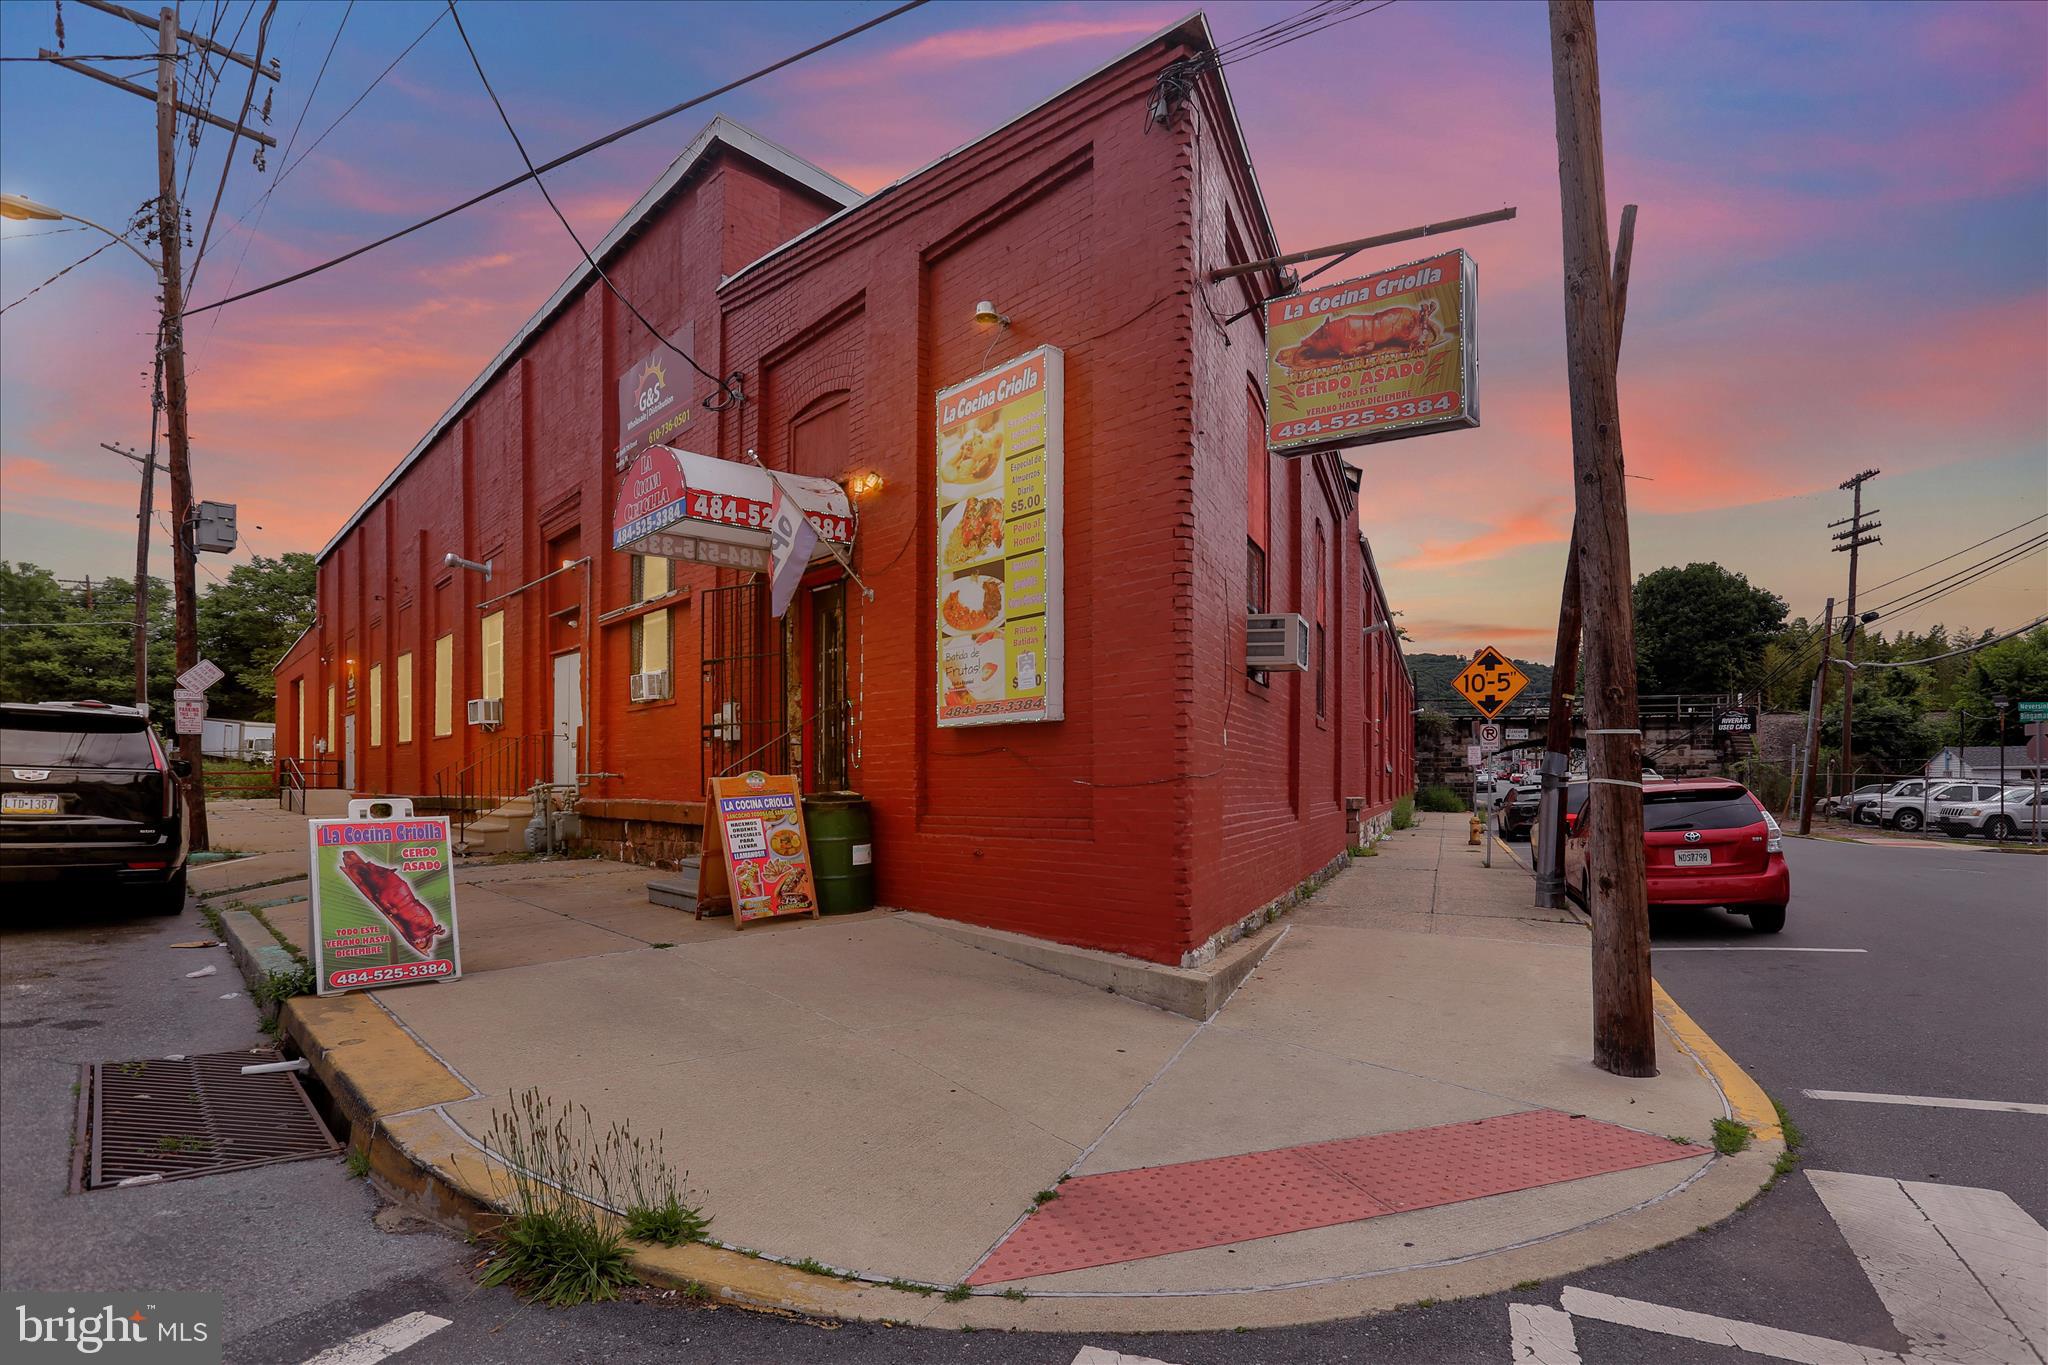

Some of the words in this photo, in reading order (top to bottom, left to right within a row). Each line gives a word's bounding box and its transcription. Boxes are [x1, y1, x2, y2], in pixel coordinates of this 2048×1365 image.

[1283, 304, 1303, 320] La
[1309, 288, 1370, 314] Cocina
[1376, 267, 1442, 297] Criolla
[1295, 375, 1351, 398] CERDO
[1360, 360, 1425, 385] ASADO
[639, 382, 660, 412] G&S
[943, 405, 955, 425] La
[958, 389, 995, 418] Cocina
[997, 367, 1038, 401] Criolla
[1338, 390, 1357, 399] TODO
[1360, 386, 1378, 395] ESTE
[1307, 405, 1337, 416] VERANO
[1339, 400, 1366, 411] HASTA
[1367, 390, 1411, 404] DICIEMBRE
[649, 409, 690, 443] 610-736-0501
[1278, 397, 1451, 438] 484-525-3384
[1011, 457, 1033, 471] Especial
[1011, 494, 1040, 513] $5.00
[616, 502, 681, 544] 484-525-3384
[1013, 522, 1031, 534] Pollo
[946, 651, 968, 662] Batida
[970, 647, 980, 658] de
[945, 659, 981, 678] Frutas!
[945, 697, 1043, 717] 484-525-3384
[724, 801, 734, 811] LA
[735, 798, 764, 810] COCINA
[764, 796, 793, 808] CRIOLLA
[323, 827, 340, 844] La
[344, 825, 392, 842] Cocina
[397, 823, 442, 840] Criolla
[401, 847, 438, 858] CERDO
[402, 860, 441, 872] ASADO
[336, 928, 358, 937] TODO
[360, 926, 380, 934] ESTE
[326, 938, 361, 948] VERANO
[362, 935, 391, 945] HASTA
[335, 946, 382, 958] DICIEMBRE
[336, 962, 448, 986] 484-525-3384
